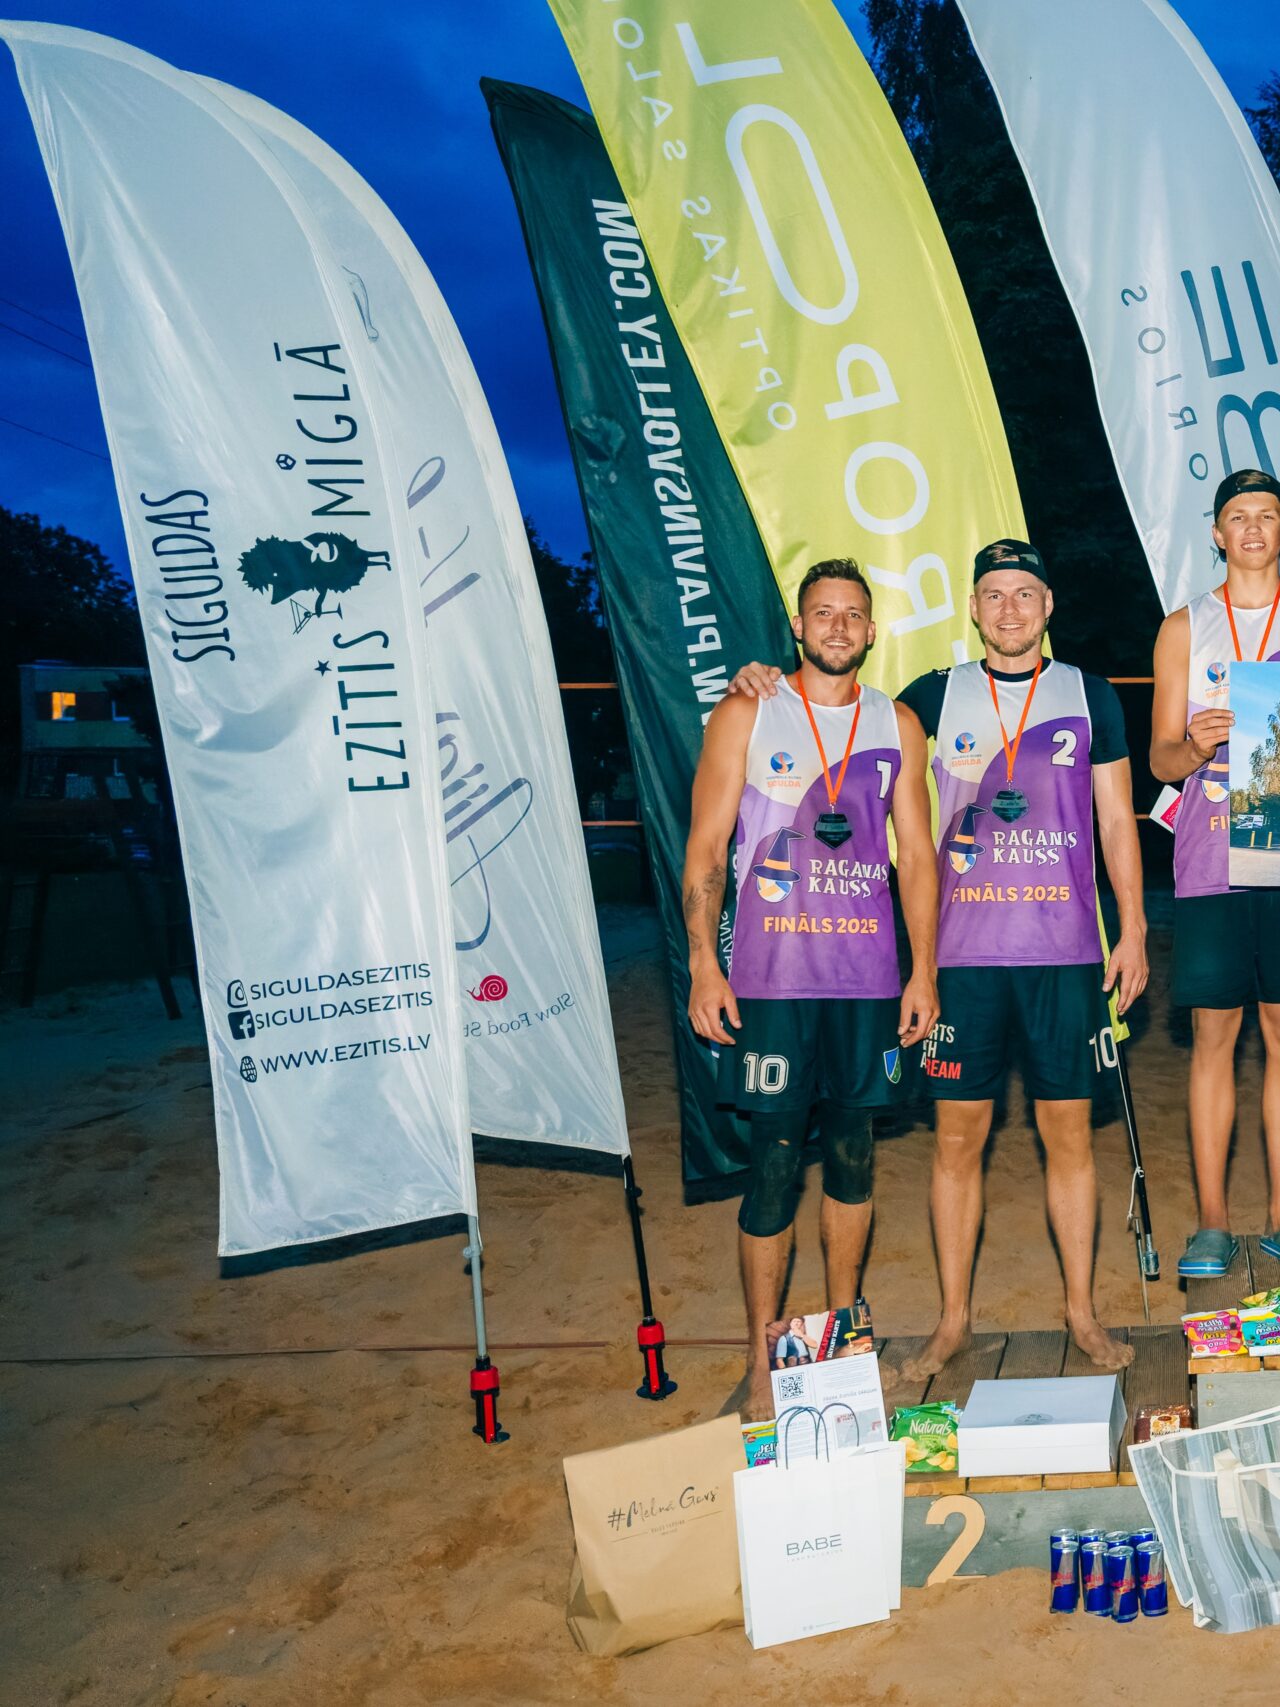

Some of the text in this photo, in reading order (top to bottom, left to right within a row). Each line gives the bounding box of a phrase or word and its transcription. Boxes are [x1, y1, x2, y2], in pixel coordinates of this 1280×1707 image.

[273, 342, 371, 518] MIGLĀ
[140, 489, 236, 662] SIGULDAS
[332, 629, 410, 792] EZĪTIS
[1050, 729, 1078, 769] 2
[876, 759, 892, 800] 1
[809, 859, 889, 882] RAGANAS
[992, 848, 1060, 866] KAUSS
[808, 876, 872, 898] KAUSS
[951, 882, 1071, 903] FINĀLS 2025
[763, 912, 879, 934] FINĀLS 2025
[249, 961, 432, 1000] SIGULDASEZITIS
[254, 990, 434, 1031] SIGULDASEZITIS
[259, 1033, 432, 1076] WWW.EZITIS.LV
[1088, 1026, 1119, 1074] 10
[743, 1050, 790, 1095] 10
[909, 1417, 952, 1435] Naturals
[925, 1494, 987, 1588] 2
